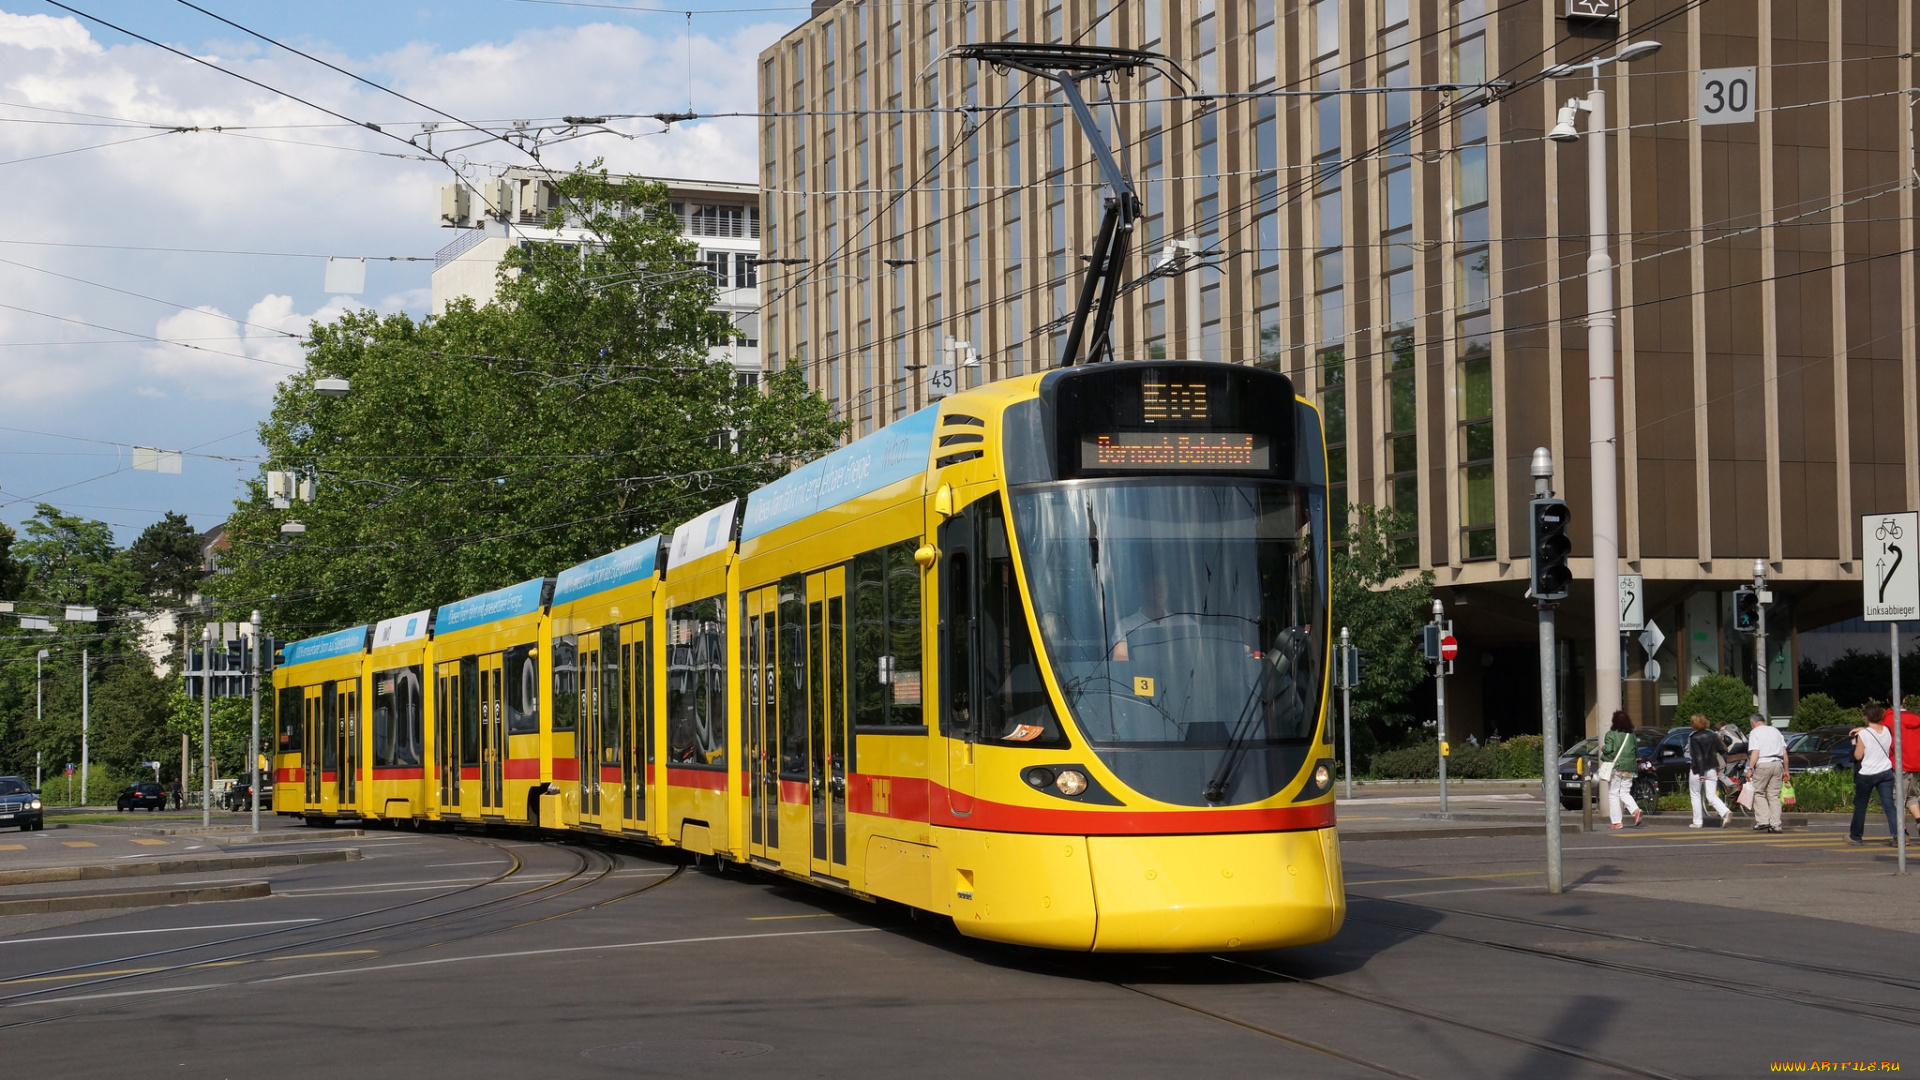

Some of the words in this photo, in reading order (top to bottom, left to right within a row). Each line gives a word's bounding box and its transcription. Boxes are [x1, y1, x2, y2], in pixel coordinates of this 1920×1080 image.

[1704, 79, 1748, 114] 30
[932, 370, 952, 388] 45
[1866, 605, 1915, 617] Linksabbieger
[1141, 680, 1148, 690] 3
